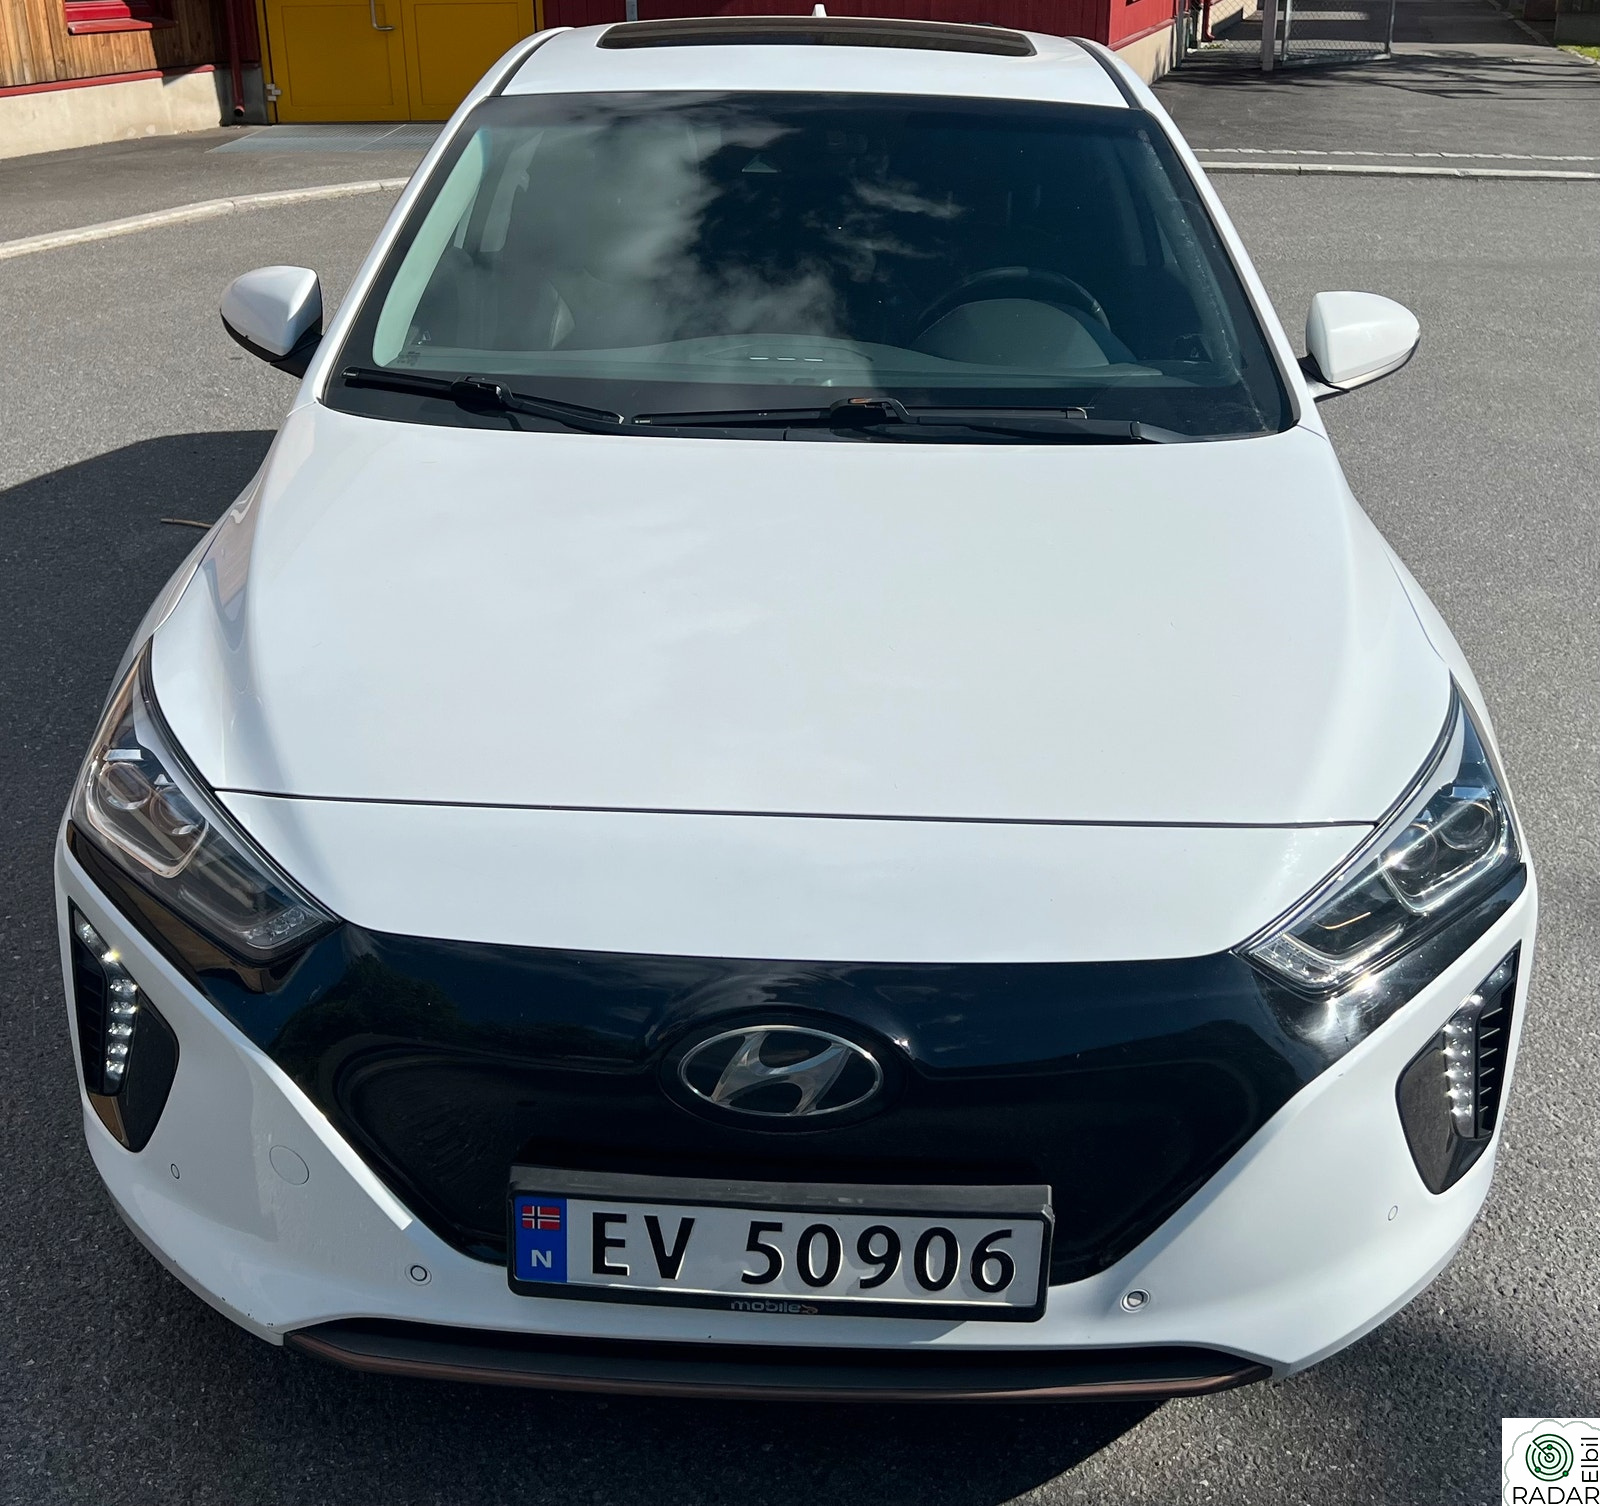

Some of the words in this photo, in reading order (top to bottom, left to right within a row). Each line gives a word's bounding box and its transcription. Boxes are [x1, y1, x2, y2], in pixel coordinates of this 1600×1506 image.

[531, 1249, 552, 1269] N
[592, 1212, 696, 1281] EV
[741, 1221, 1016, 1294] 50906
